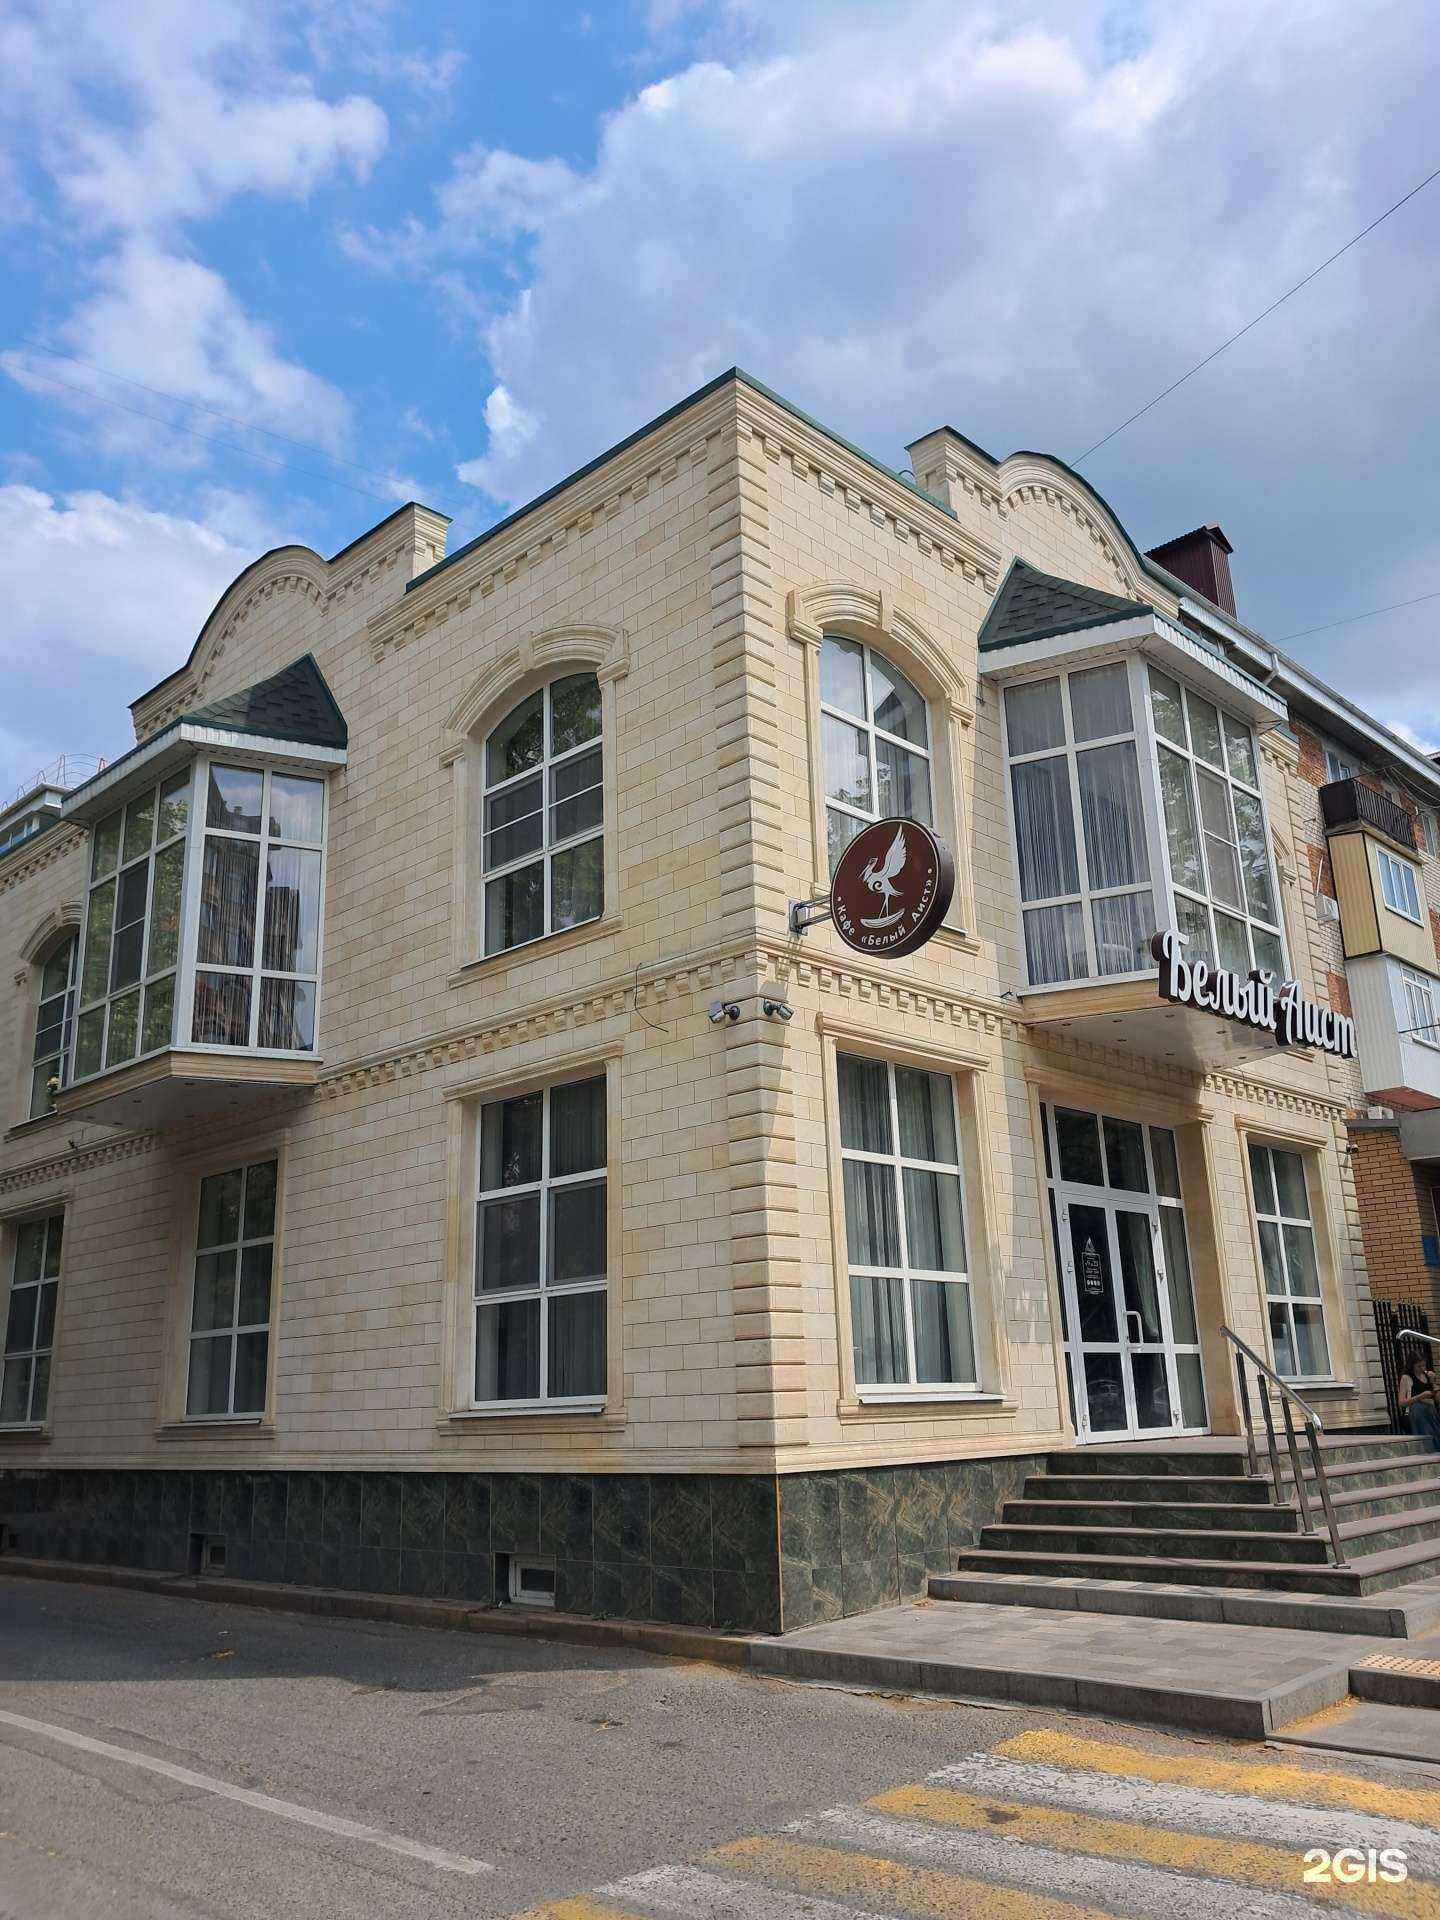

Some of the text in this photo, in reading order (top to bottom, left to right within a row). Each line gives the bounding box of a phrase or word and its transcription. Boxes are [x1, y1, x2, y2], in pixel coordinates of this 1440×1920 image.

[836, 903, 855, 936] Кафе
[1160, 928, 1358, 1058] Белый Аист
